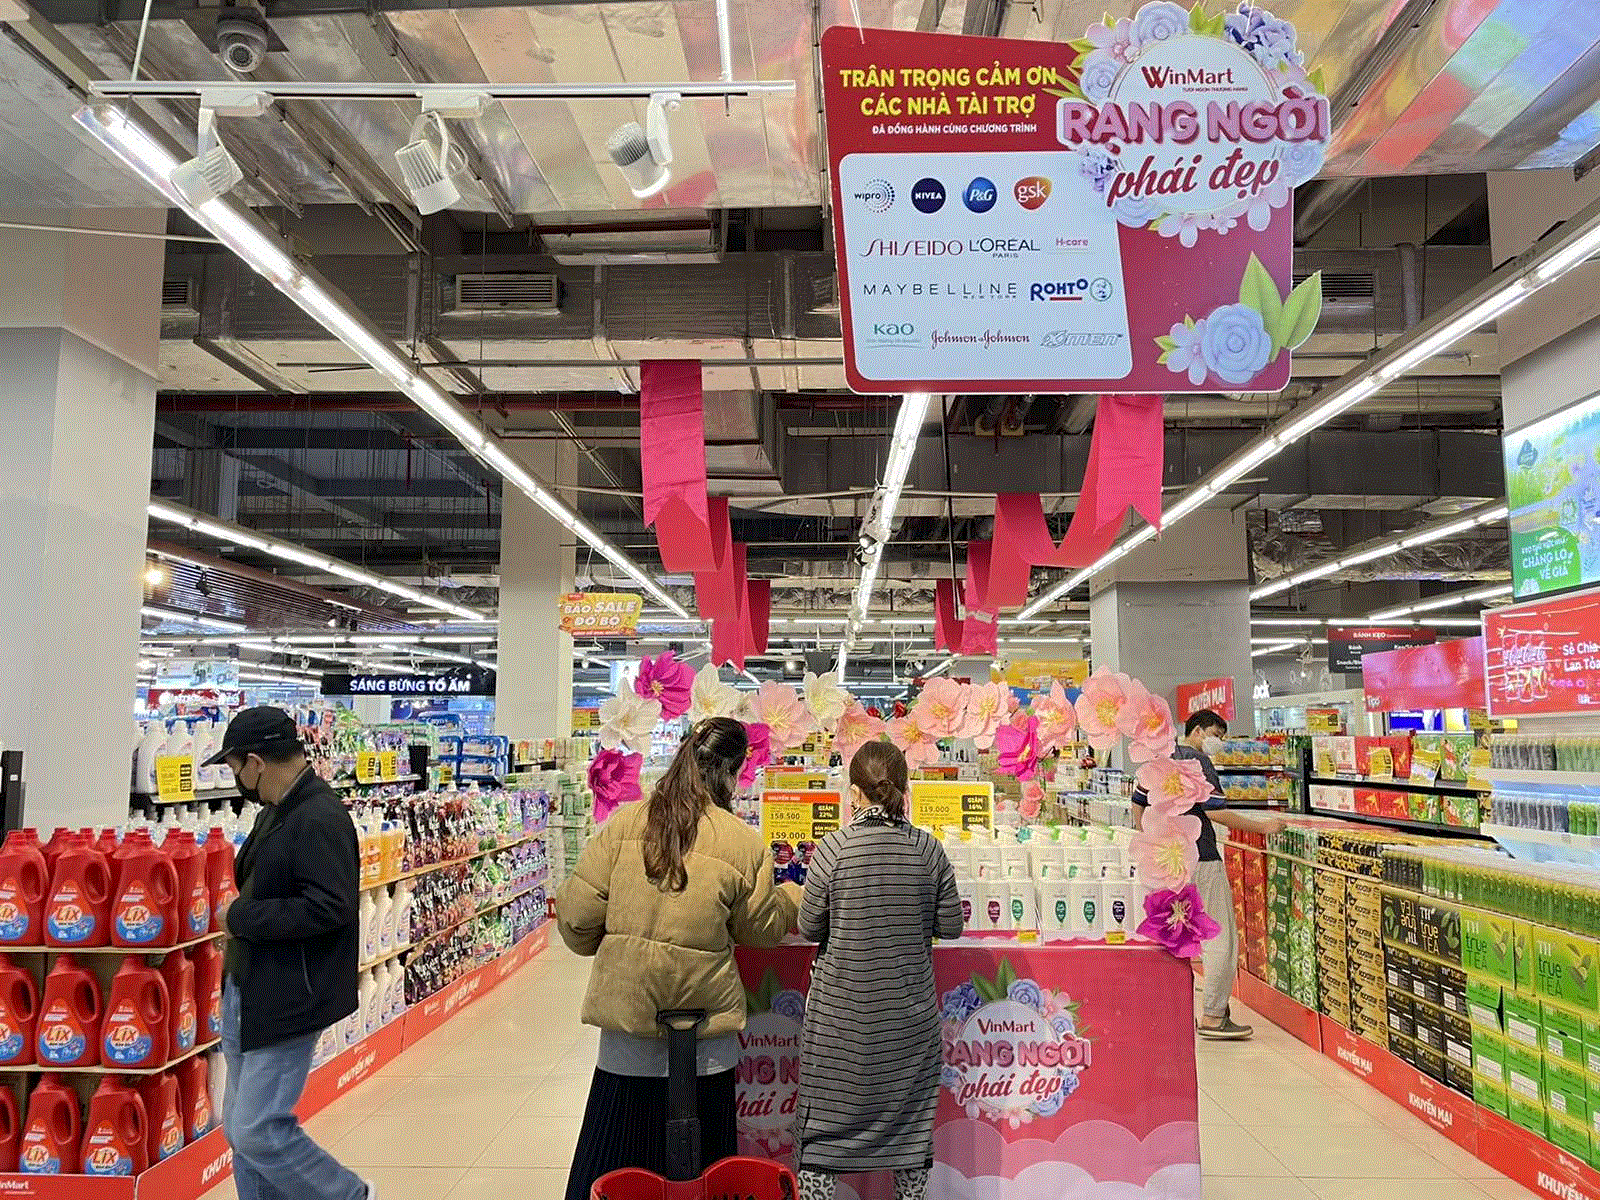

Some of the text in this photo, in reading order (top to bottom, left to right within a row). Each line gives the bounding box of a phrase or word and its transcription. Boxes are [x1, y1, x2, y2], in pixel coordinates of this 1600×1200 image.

[839, 60, 1057, 91] TRÂN TRỌNG CẢM ƠN
[1141, 65, 1234, 89] WinMart
[860, 91, 1037, 118] CÁC NHÀ TÀI TRỢ
[887, 122, 914, 135] ĐỒNG
[914, 122, 941, 134] HÀNH
[942, 122, 969, 134] CÙNG
[970, 122, 1009, 134] CHƯƠNG
[1009, 121, 1038, 133] TRÌNH
[1063, 85, 1330, 155] RẠNG NGỜI
[1106, 147, 1280, 208] phái đẹp
[853, 190, 882, 203] wipro
[914, 191, 942, 200] NIVEA
[969, 188, 994, 202] P&G
[1017, 181, 1048, 203] gsk
[859, 238, 963, 258] SHISEIDO
[863, 282, 1018, 296] MAYBELLINE
[1030, 278, 1089, 302] ROHTO
[594, 601, 637, 614] SALE
[350, 678, 386, 692] SÁNG
[388, 678, 425, 692] BỪNG
[770, 831, 806, 840] 159.000
[1421, 920, 1440, 939] true
[1422, 937, 1441, 957] TEA
[1465, 934, 1488, 952] true
[1538, 956, 1563, 980] true
[978, 1018, 1036, 1035] VinMart
[737, 1031, 800, 1050] VinMart
[1018, 1033, 1091, 1070] NGỜI
[959, 1070, 1062, 1104] phái đẹp
[736, 1090, 777, 1118] hái
[1408, 1091, 1453, 1127] KHUYẾN MẠI
